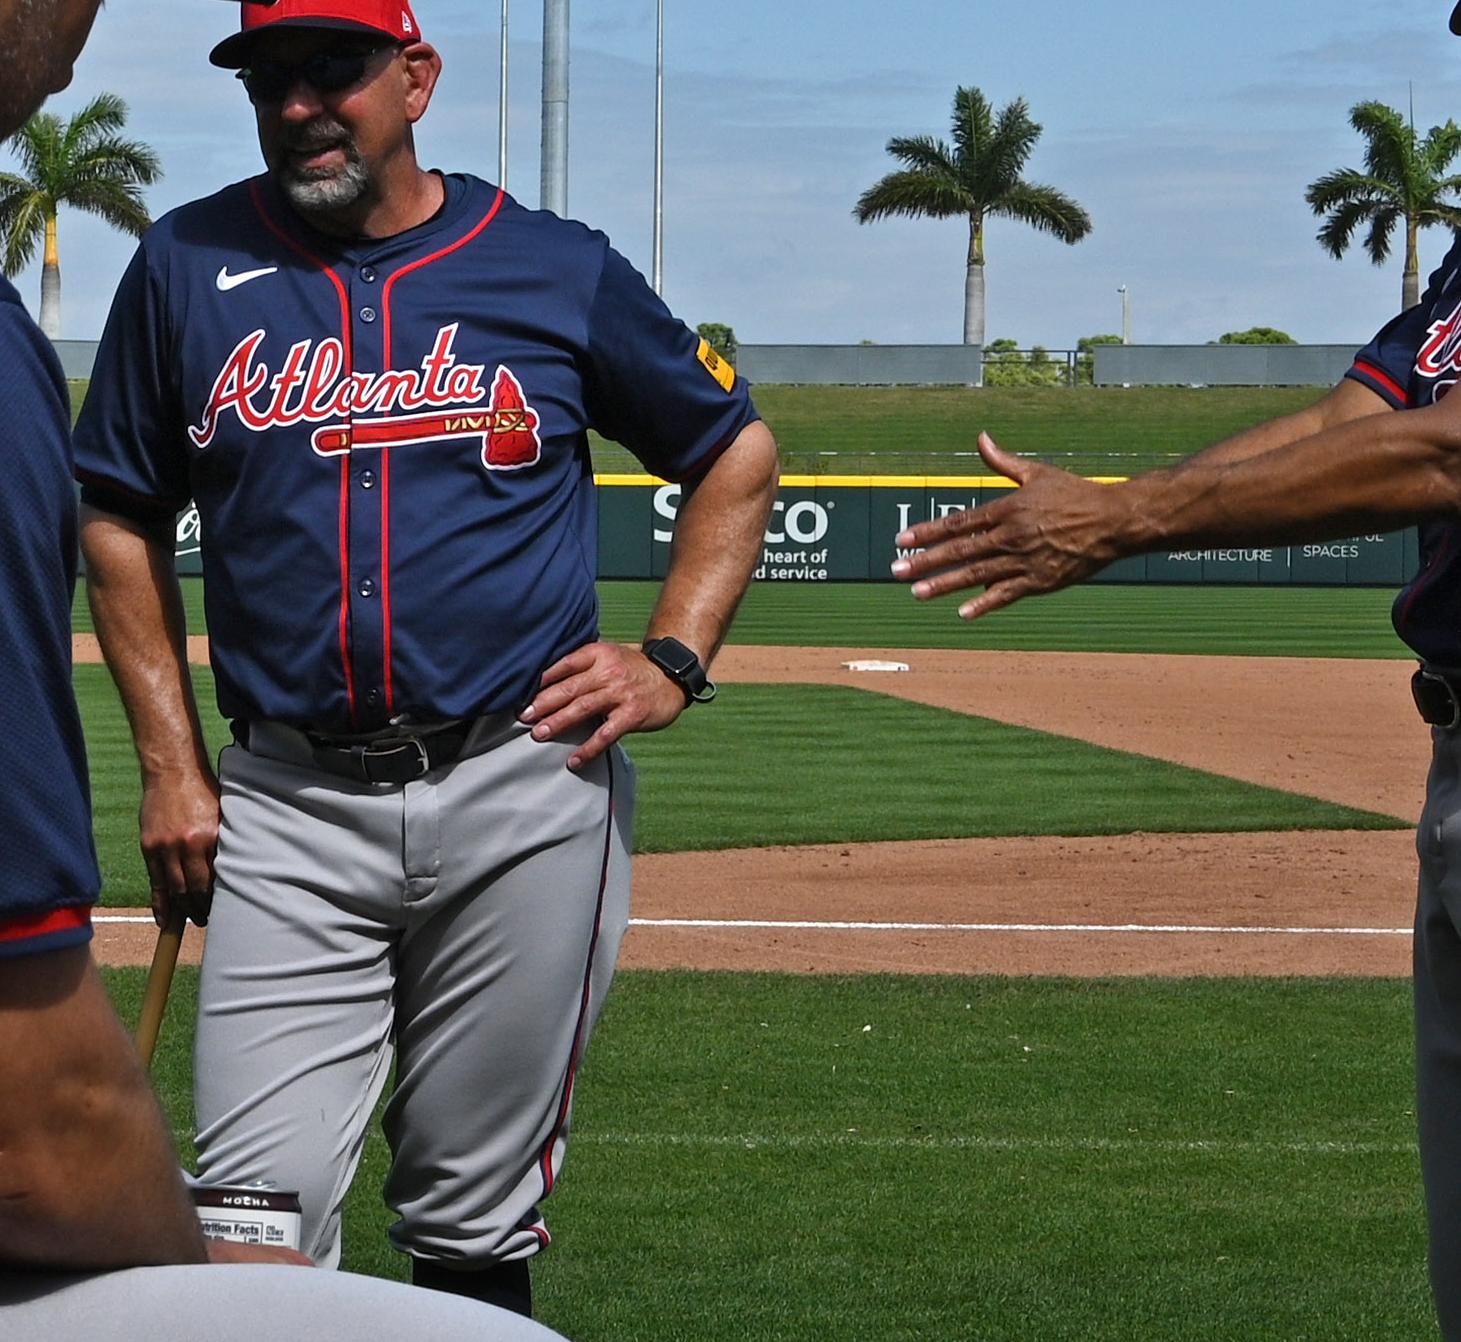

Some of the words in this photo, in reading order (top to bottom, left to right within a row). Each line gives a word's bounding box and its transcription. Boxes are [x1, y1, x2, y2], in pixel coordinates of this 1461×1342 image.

[188, 322, 484, 449] Atlanta
[764, 549, 806, 564] heart
[810, 548, 829, 564] of
[1168, 549, 1272, 562] ARCHITECTURE
[1303, 544, 1359, 558] SPACES
[770, 564, 827, 580] service
[222, 1196, 270, 1207] MOCHA
[234, 1223, 259, 1235] Facts
